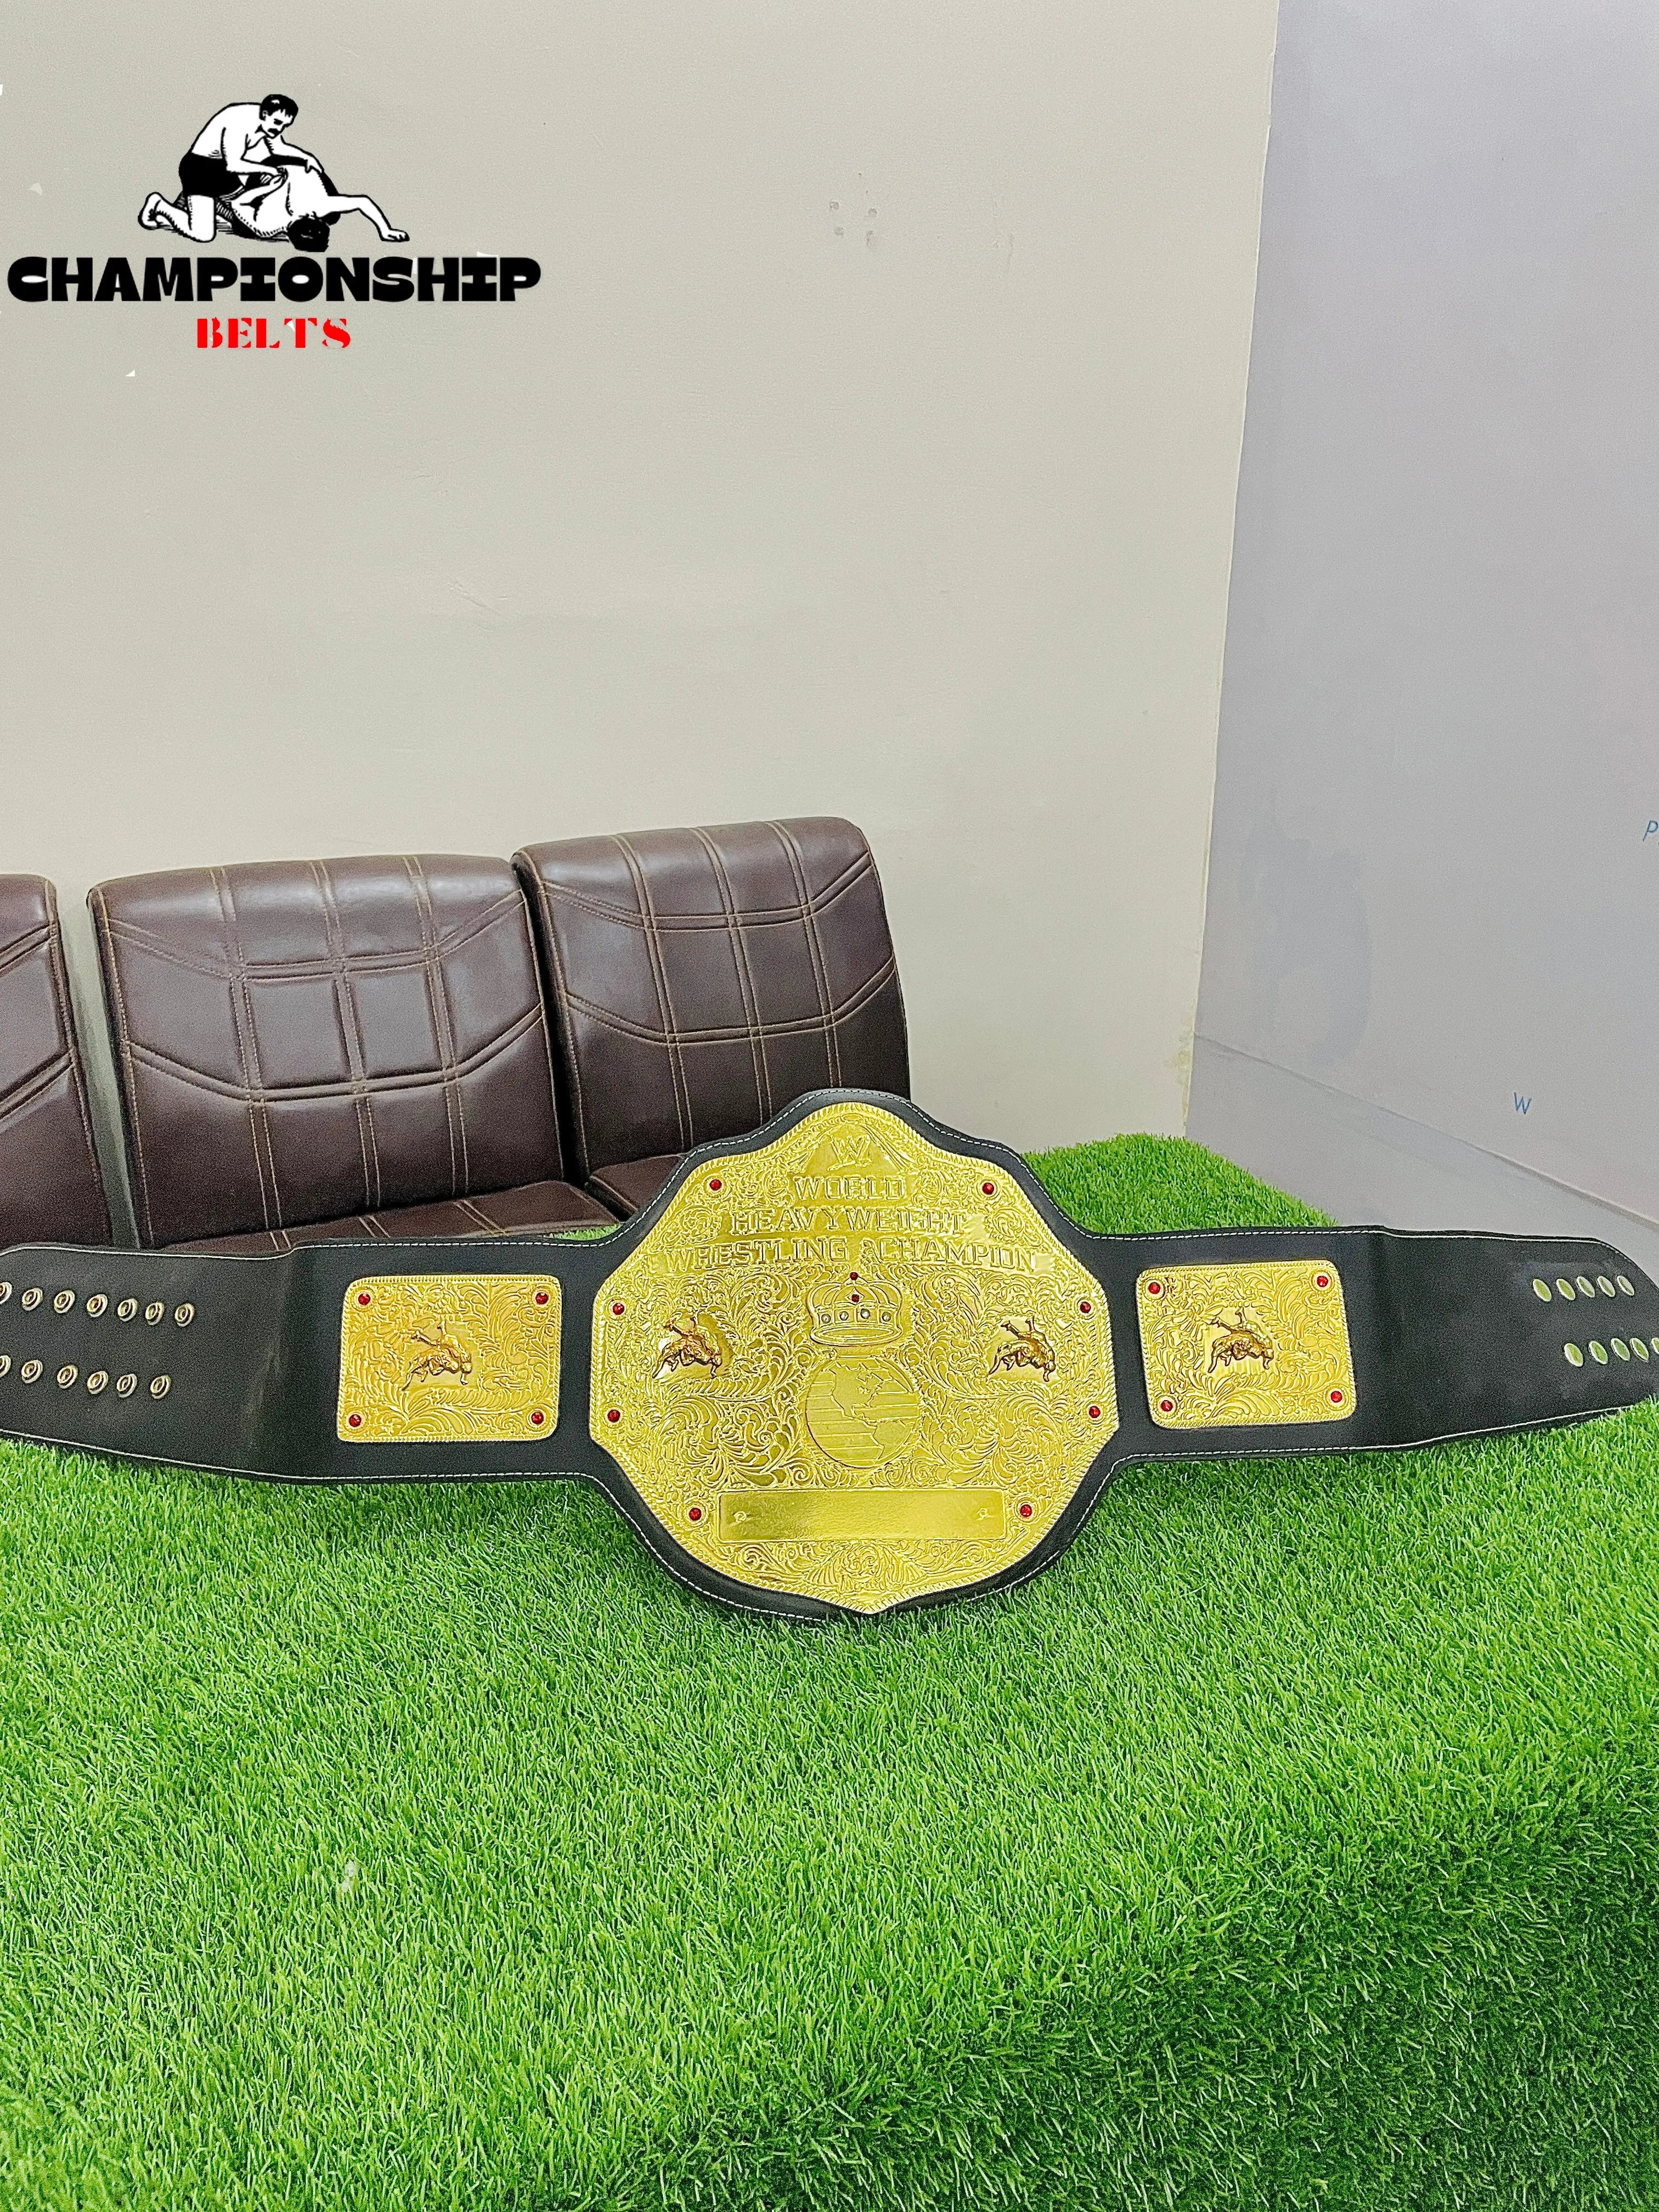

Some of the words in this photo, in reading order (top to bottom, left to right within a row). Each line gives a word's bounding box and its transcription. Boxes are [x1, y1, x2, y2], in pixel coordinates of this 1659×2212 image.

[794, 1175, 906, 1200] WORLD
[730, 1206, 965, 1236] HEAVYWEIGHT
[666, 1235, 849, 1273] WRESTLING
[878, 1236, 1036, 1273] CHAMPION
